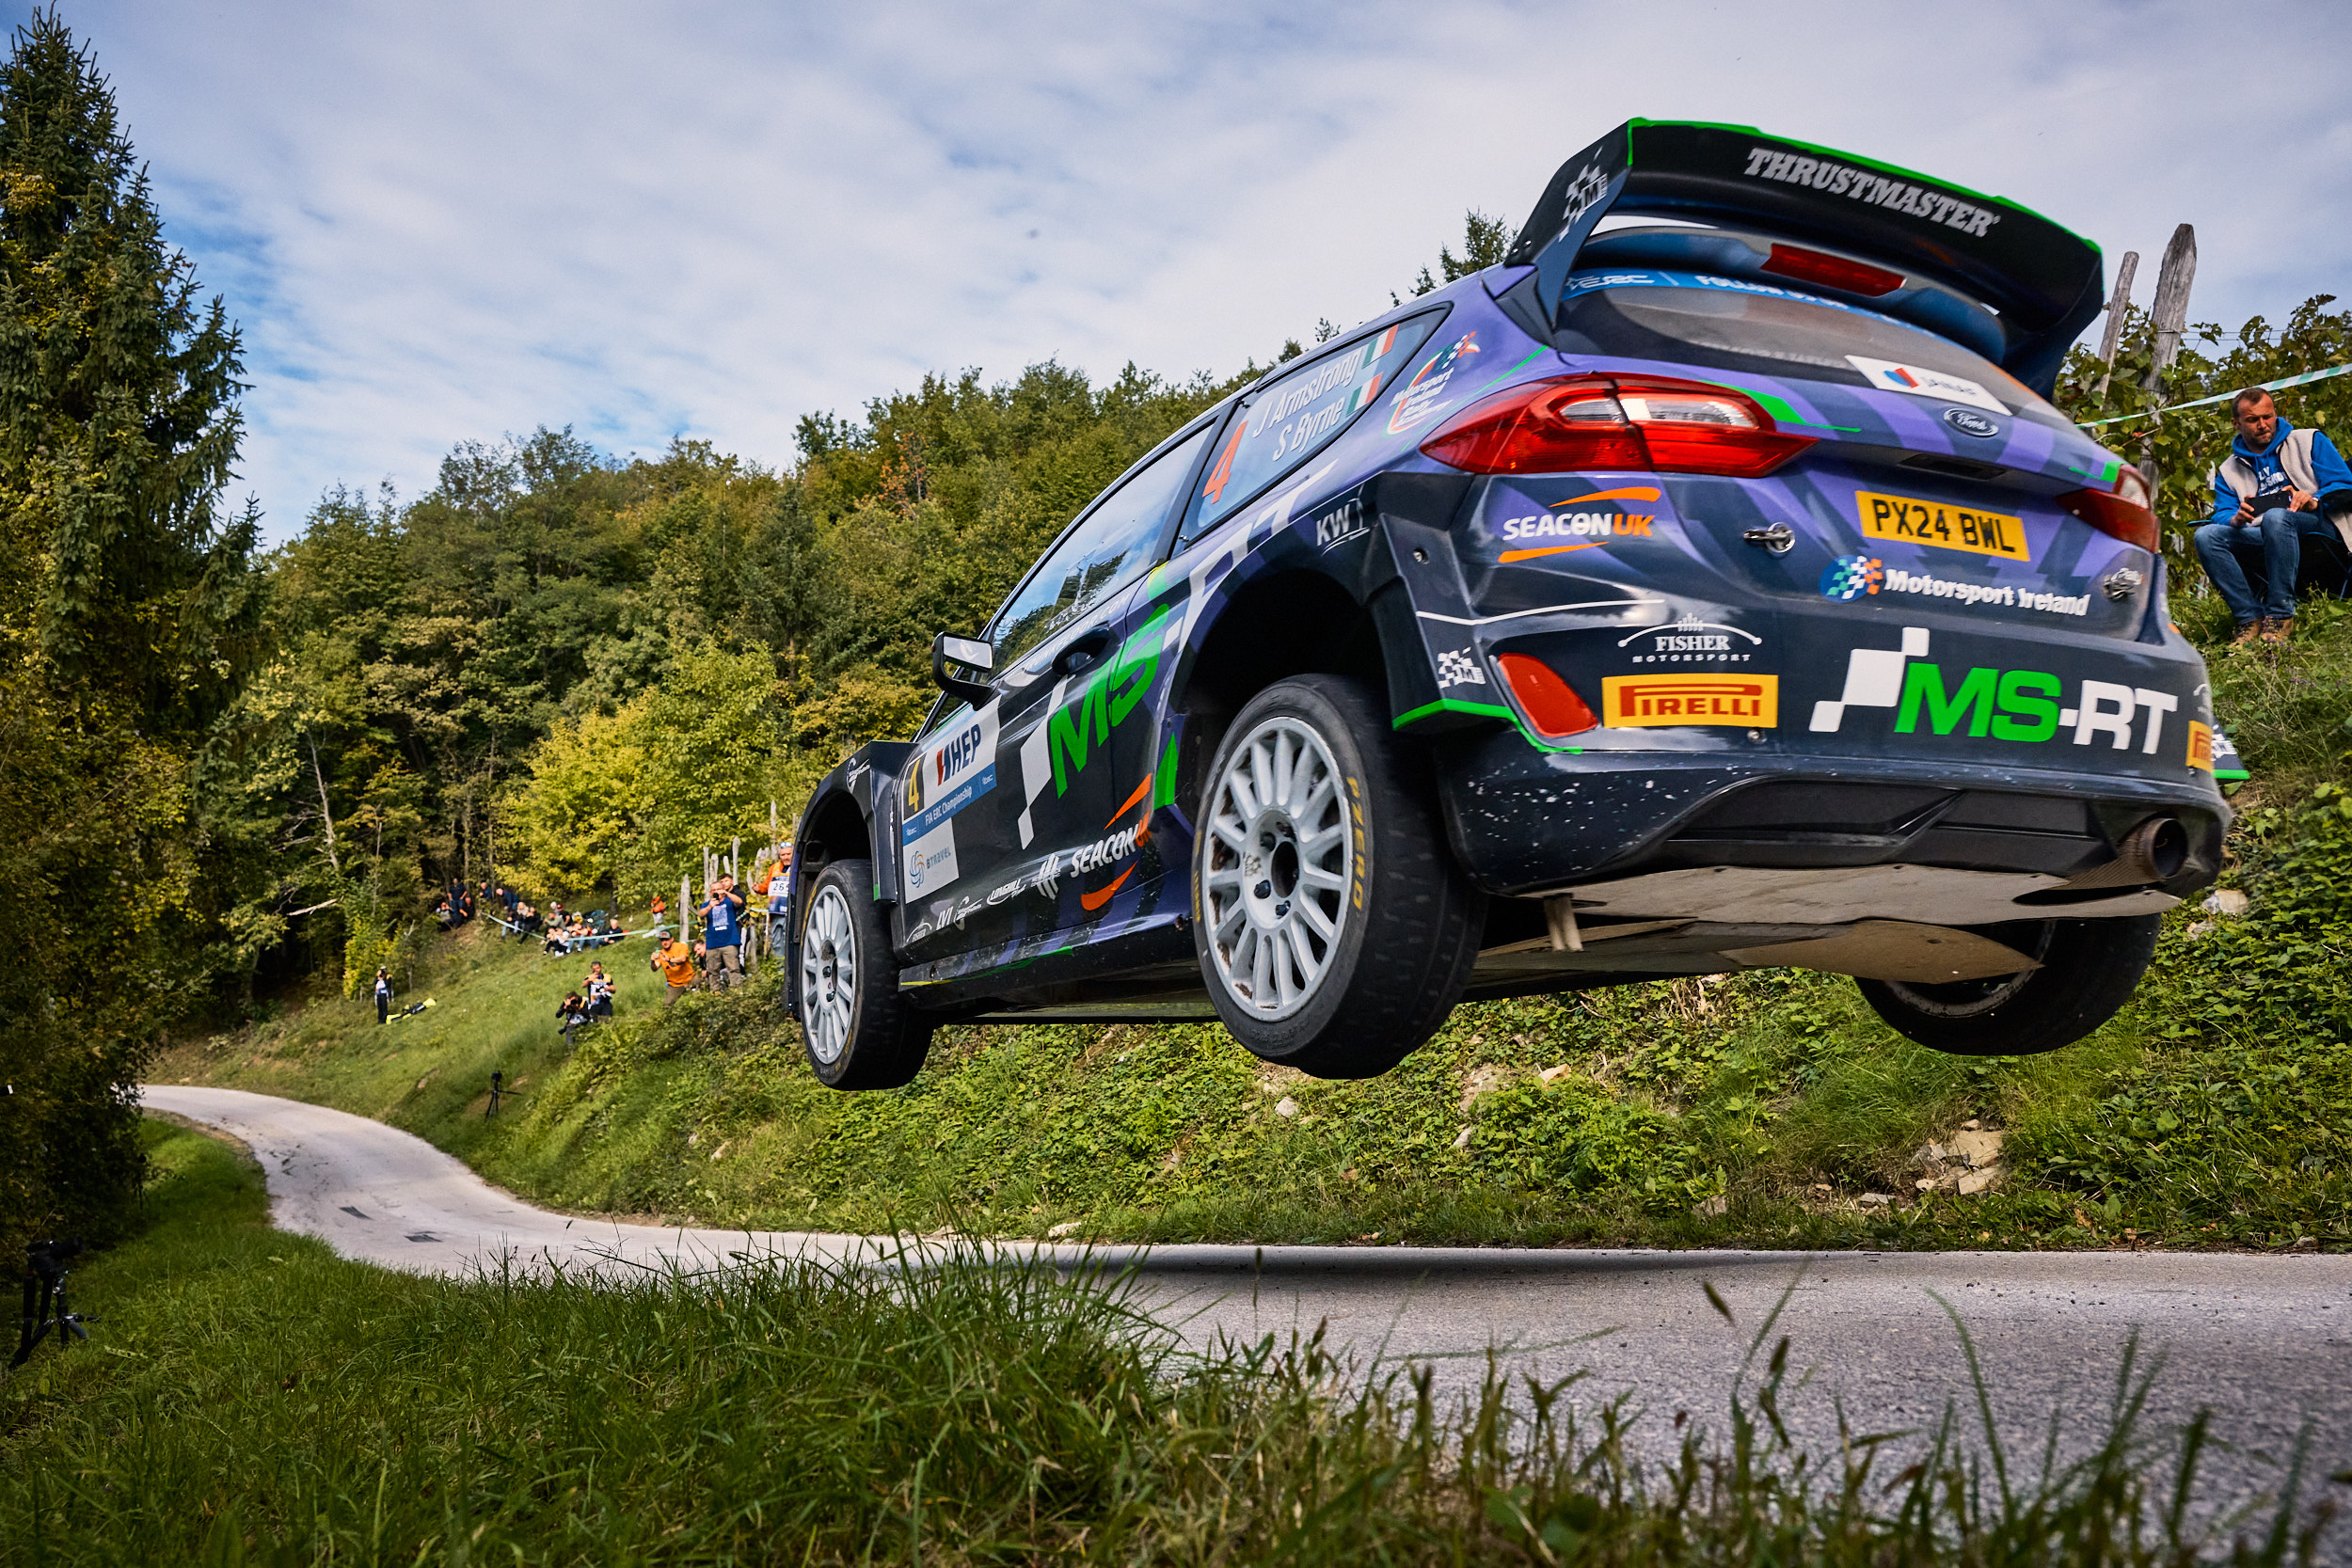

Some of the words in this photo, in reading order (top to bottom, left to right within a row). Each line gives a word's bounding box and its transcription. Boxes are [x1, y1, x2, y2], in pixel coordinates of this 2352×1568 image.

[1743, 147, 1995, 237] THRUSTMASTER
[1252, 401, 1274, 438] J
[1268, 348, 1363, 429] Armstrong
[1272, 423, 1293, 462] S
[1290, 396, 1345, 453] Byrne
[1202, 420, 1248, 504] 4
[1871, 499, 1950, 542] PX24
[1959, 513, 2016, 553] BWL
[1884, 569, 2014, 605] Motorsport
[2018, 588, 2091, 616] Ireland
[1632, 654, 1751, 663] MOTORSPORT
[1655, 635, 1731, 652] FISHER
[1619, 683, 1763, 717] PIRELLI
[1894, 662, 2179, 754] MS-RT
[950, 723, 982, 778] HEP
[908, 759, 921, 813] 4
[925, 812, 933, 827] FIA
[942, 784, 973, 816] Championship
